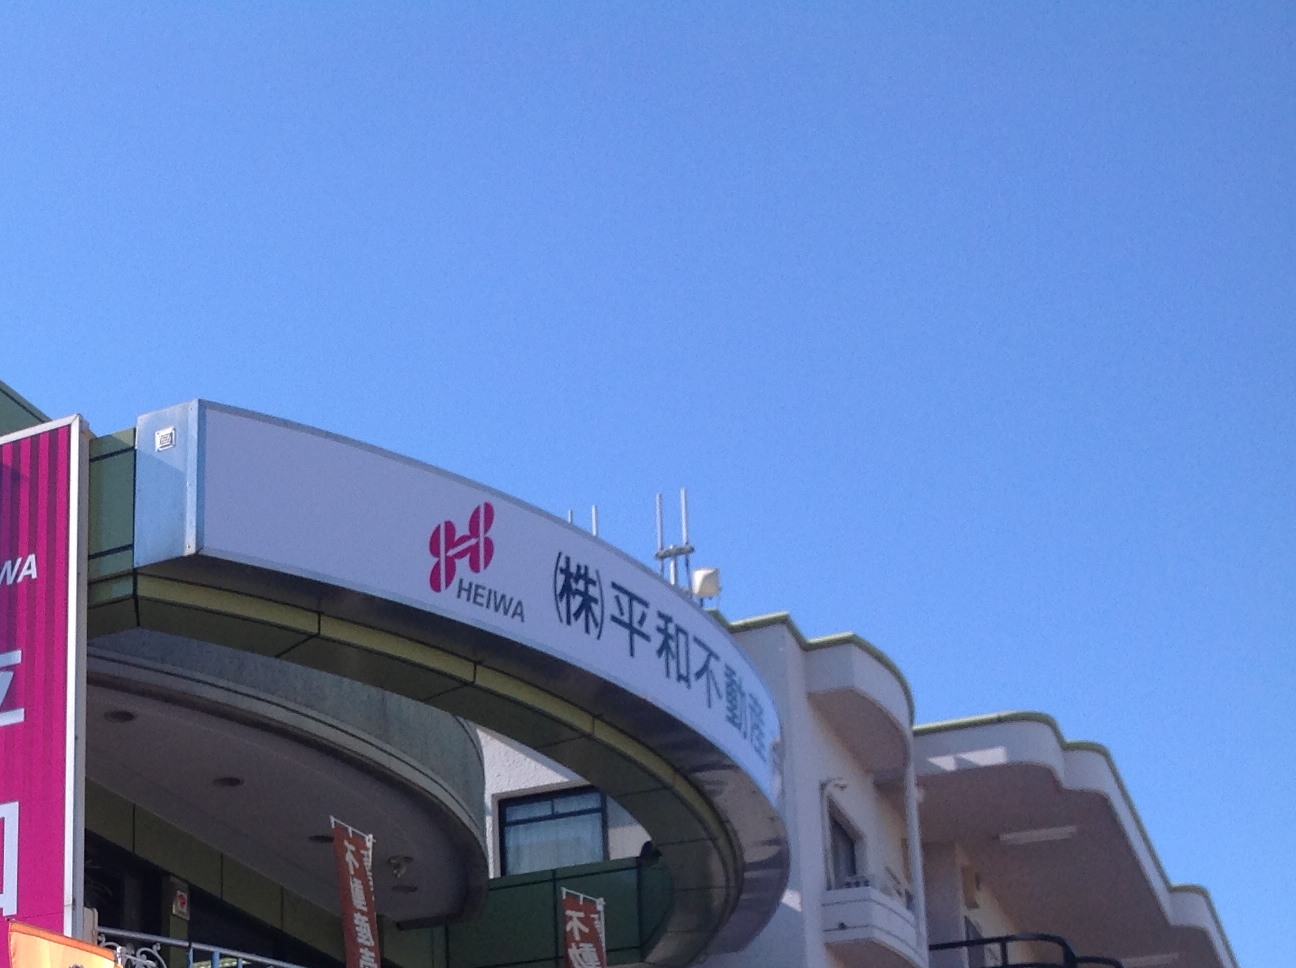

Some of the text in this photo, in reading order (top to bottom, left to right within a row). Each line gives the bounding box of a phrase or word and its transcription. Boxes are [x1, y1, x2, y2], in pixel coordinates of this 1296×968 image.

[456, 578, 525, 623] HEIWA
[553, 551, 769, 764] (株)平和不動産
